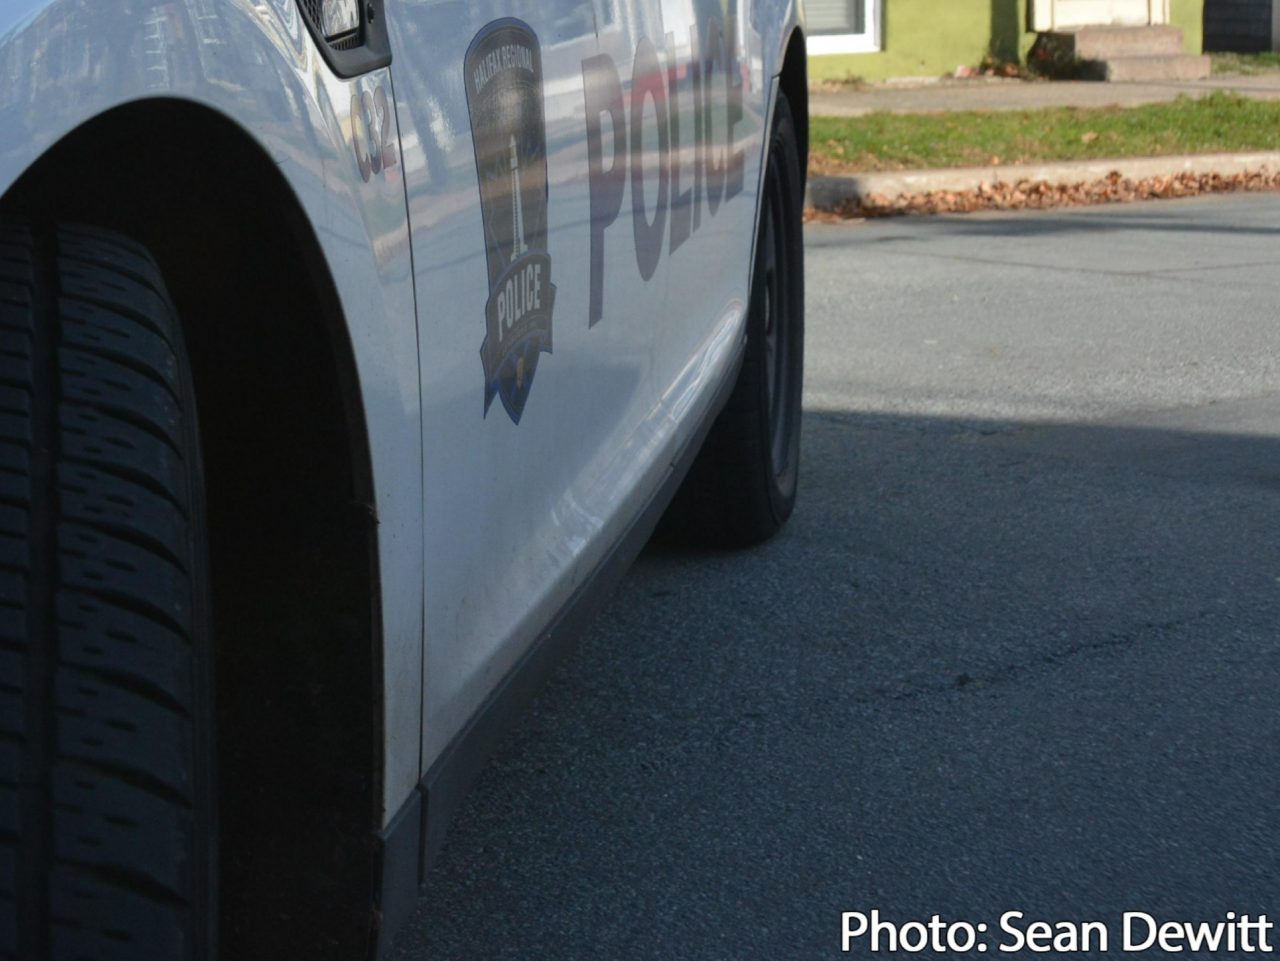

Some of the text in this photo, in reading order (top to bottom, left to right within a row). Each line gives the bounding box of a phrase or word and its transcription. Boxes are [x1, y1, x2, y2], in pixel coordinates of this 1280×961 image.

[473, 47, 502, 95] HALIFAX
[581, 15, 745, 330] POLICE
[497, 263, 541, 342] POLICE
